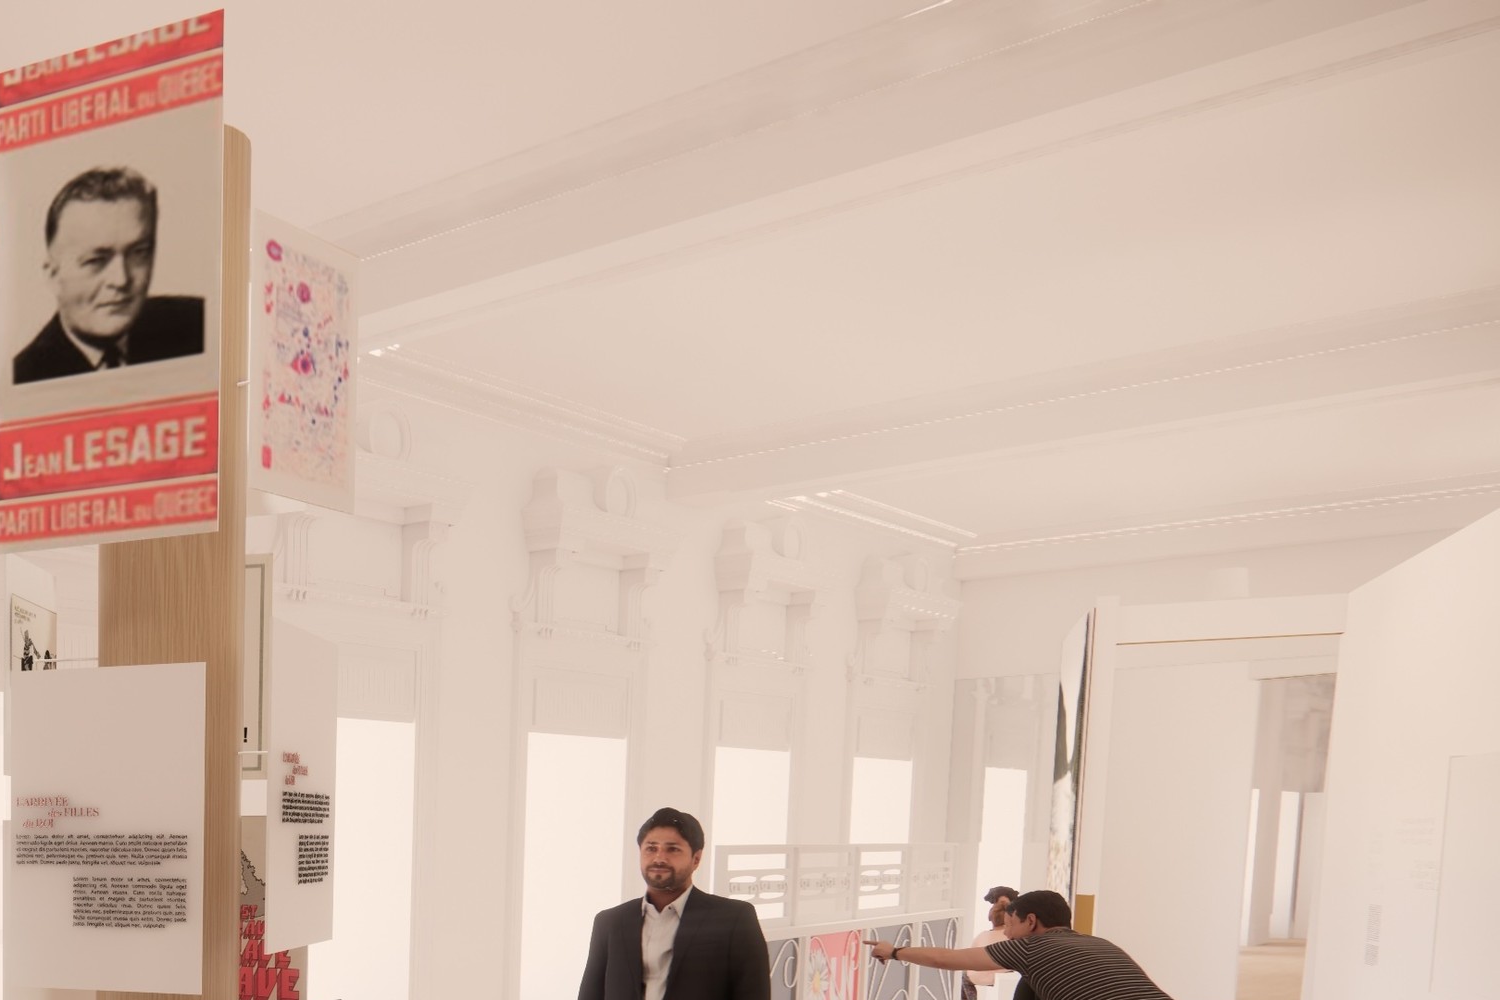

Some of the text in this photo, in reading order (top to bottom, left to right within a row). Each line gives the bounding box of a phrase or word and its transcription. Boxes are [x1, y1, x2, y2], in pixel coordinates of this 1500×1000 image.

[52, 86, 134, 132] LIBERAL
[64, 416, 207, 472] LESAGE
[52, 497, 132, 531] LIBERAL
[64, 808, 99, 817] FILLES
